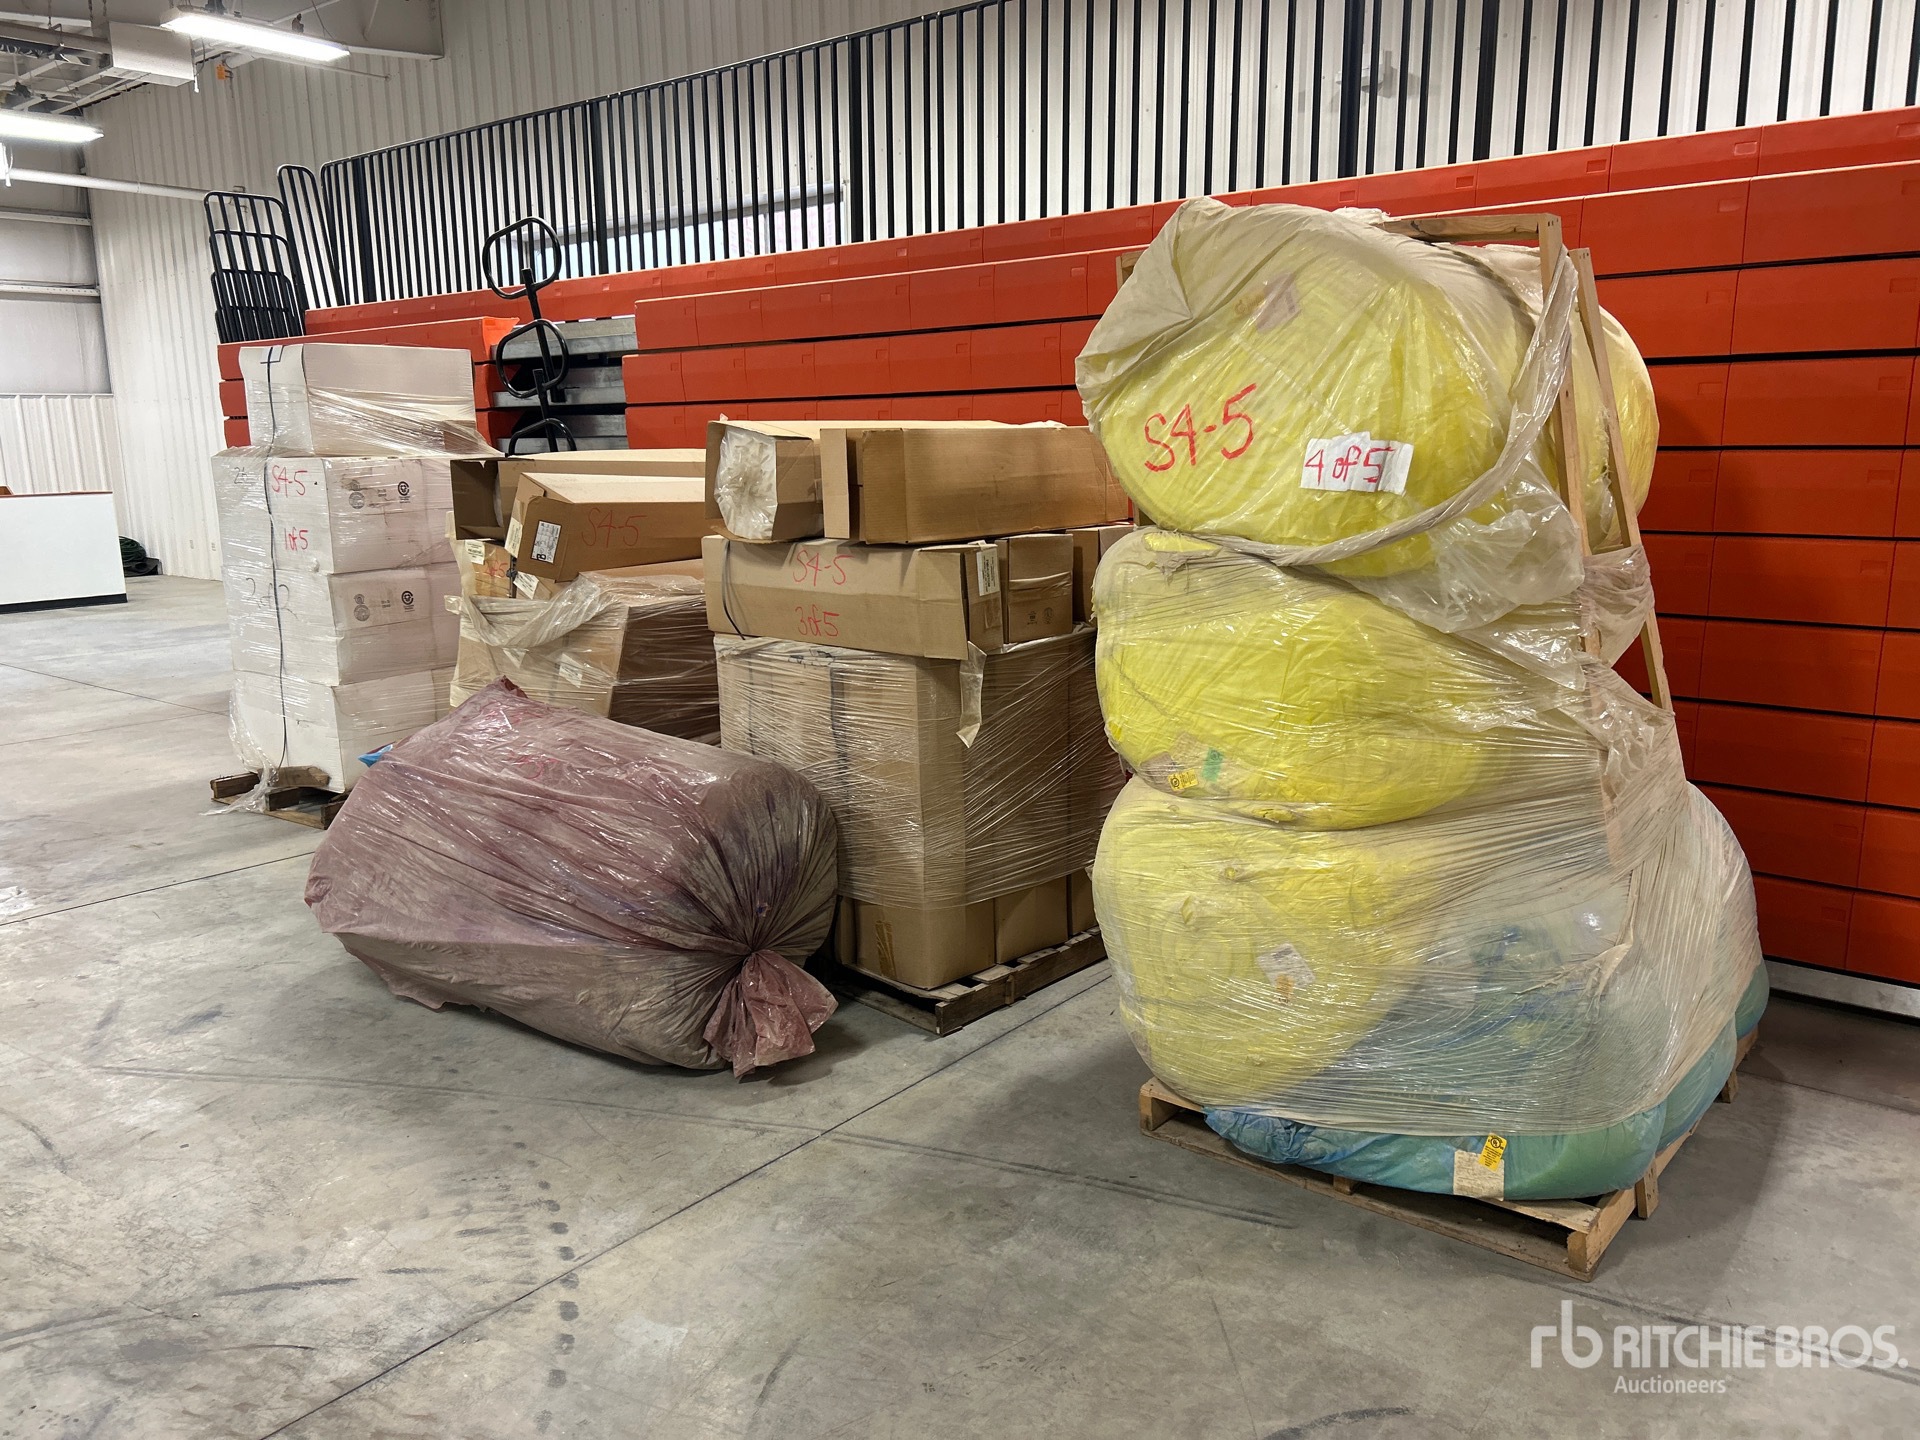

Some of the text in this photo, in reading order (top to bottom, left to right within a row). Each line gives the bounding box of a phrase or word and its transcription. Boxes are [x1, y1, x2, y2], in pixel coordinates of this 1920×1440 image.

[1144, 383, 1257, 473] S4-5
[271, 464, 309, 498] S4-5
[1304, 445, 1395, 486] 4 of 5
[581, 507, 648, 549] S4-5
[792, 549, 856, 587] S4-5
